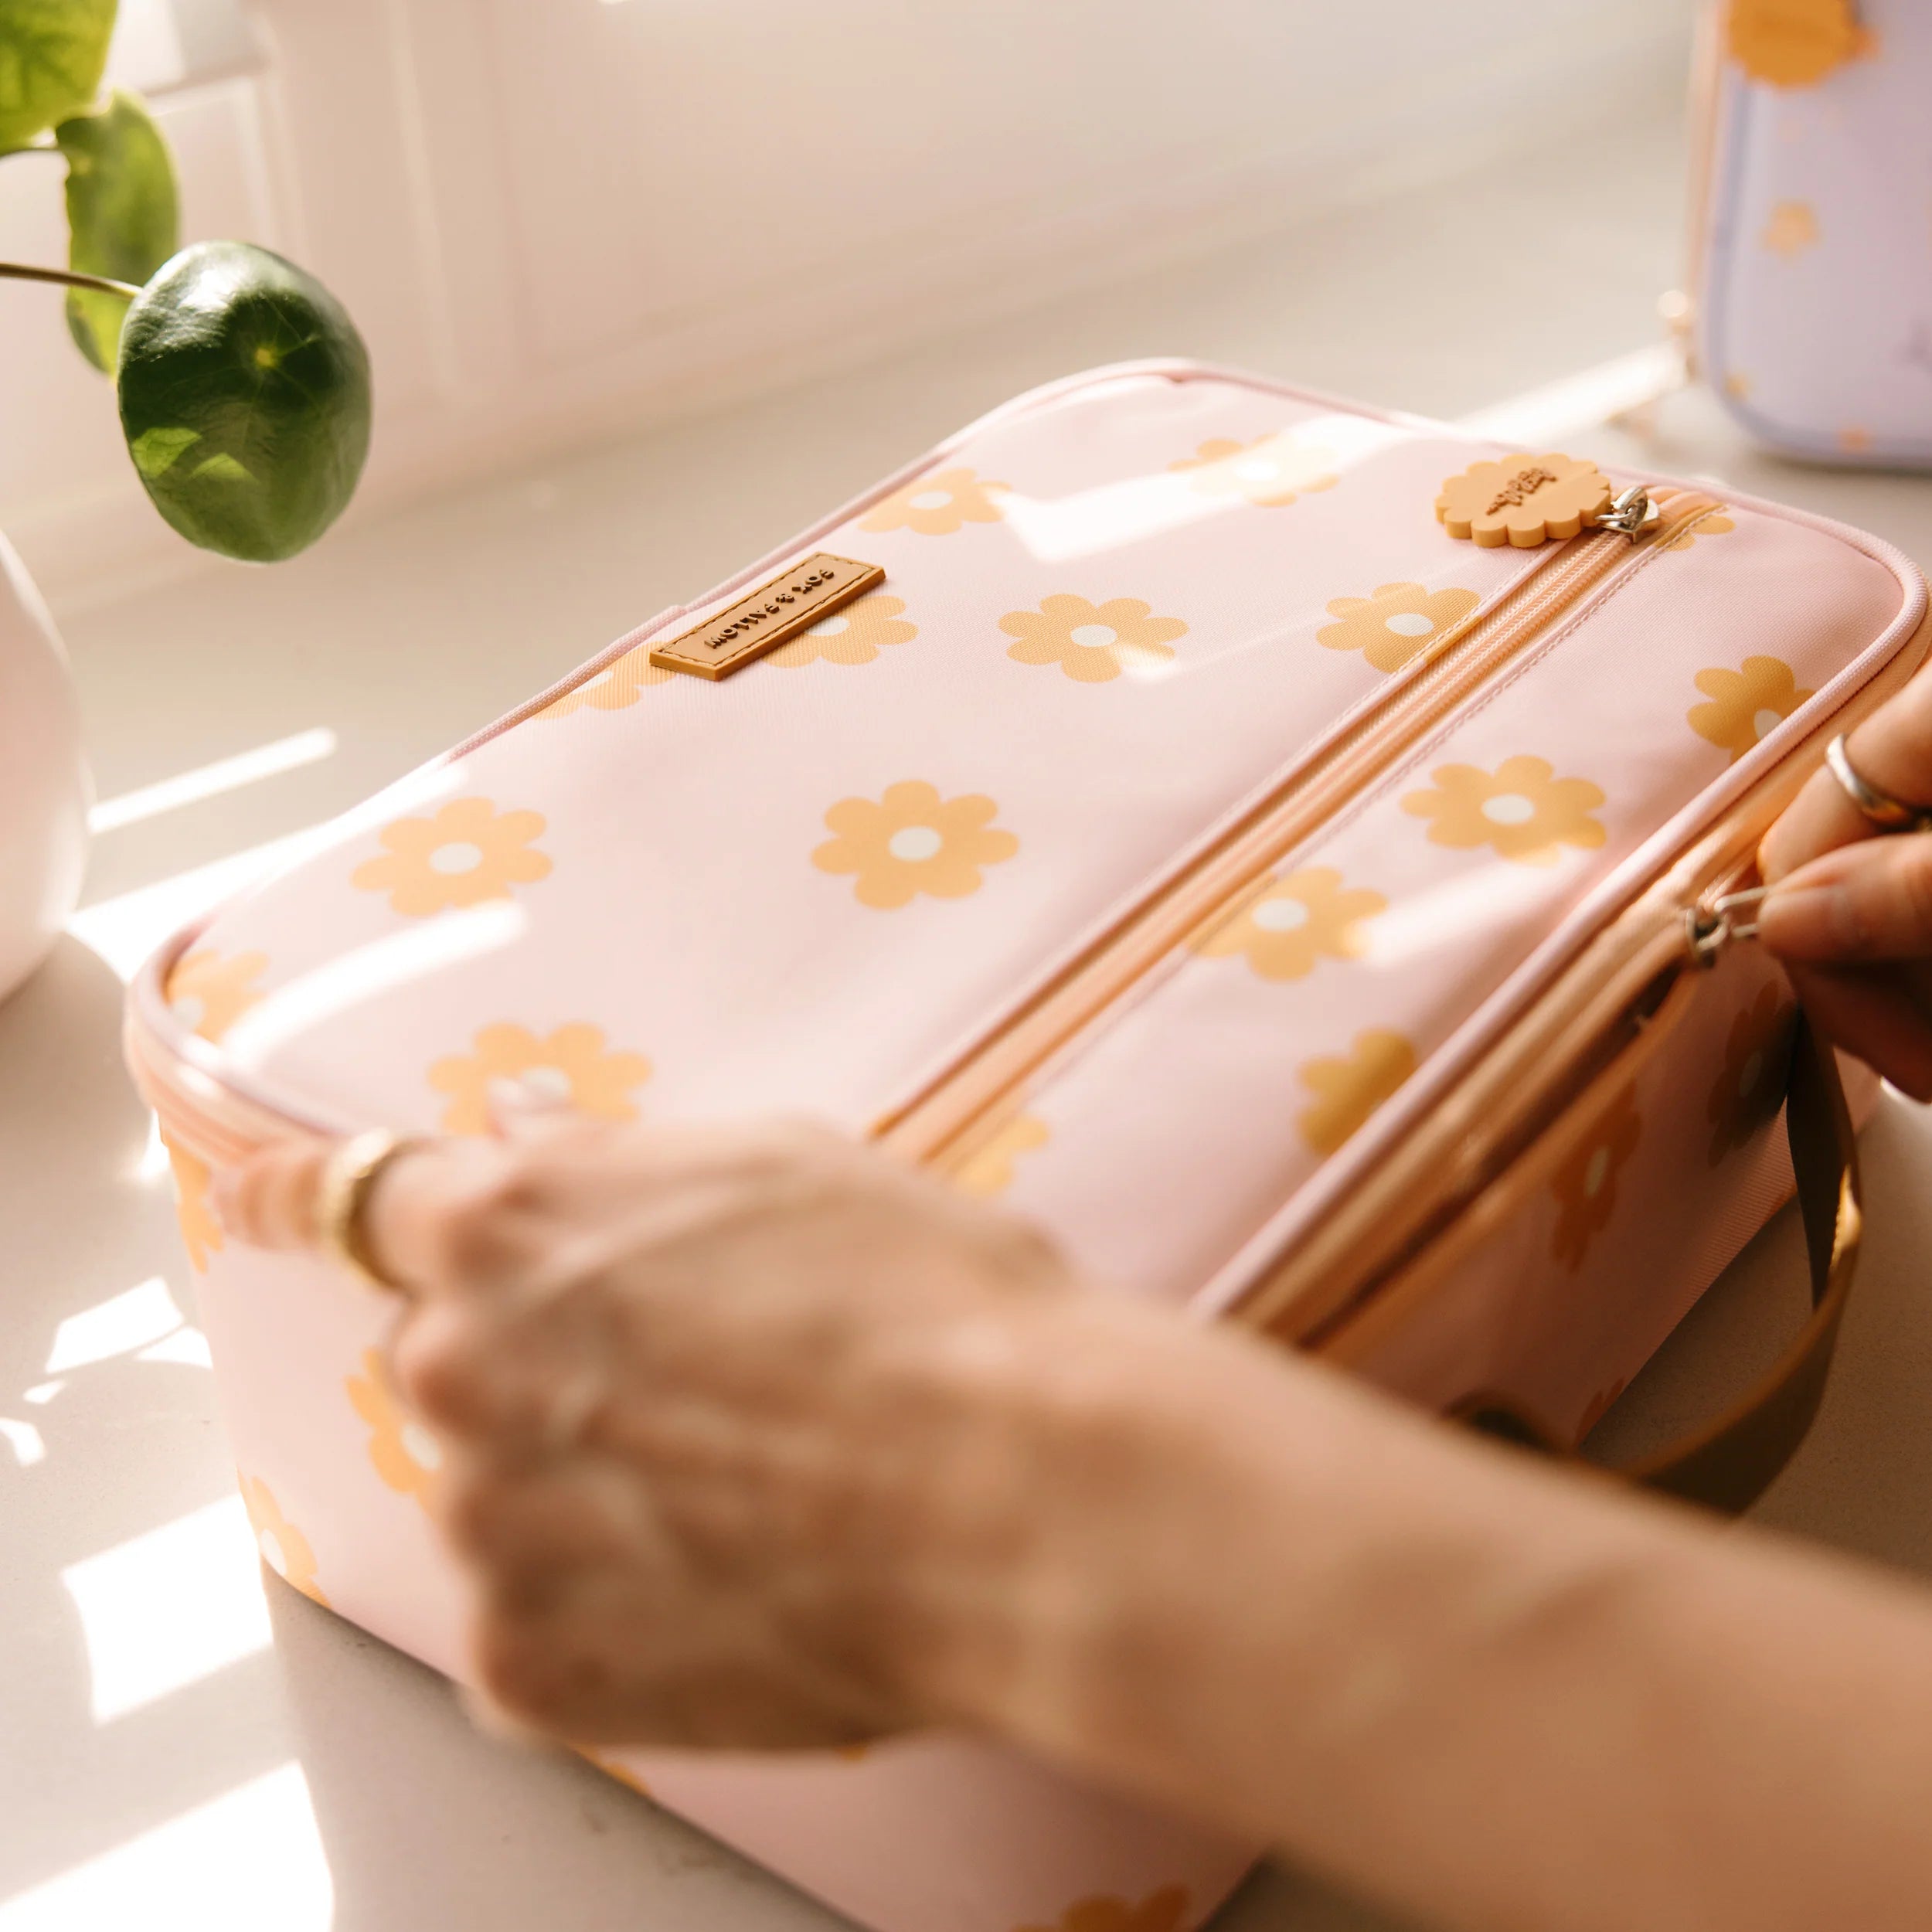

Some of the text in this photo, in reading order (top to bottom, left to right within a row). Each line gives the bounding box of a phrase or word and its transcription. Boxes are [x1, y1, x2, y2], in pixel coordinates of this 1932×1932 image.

[703, 567, 835, 650] FOX & FALLOW
